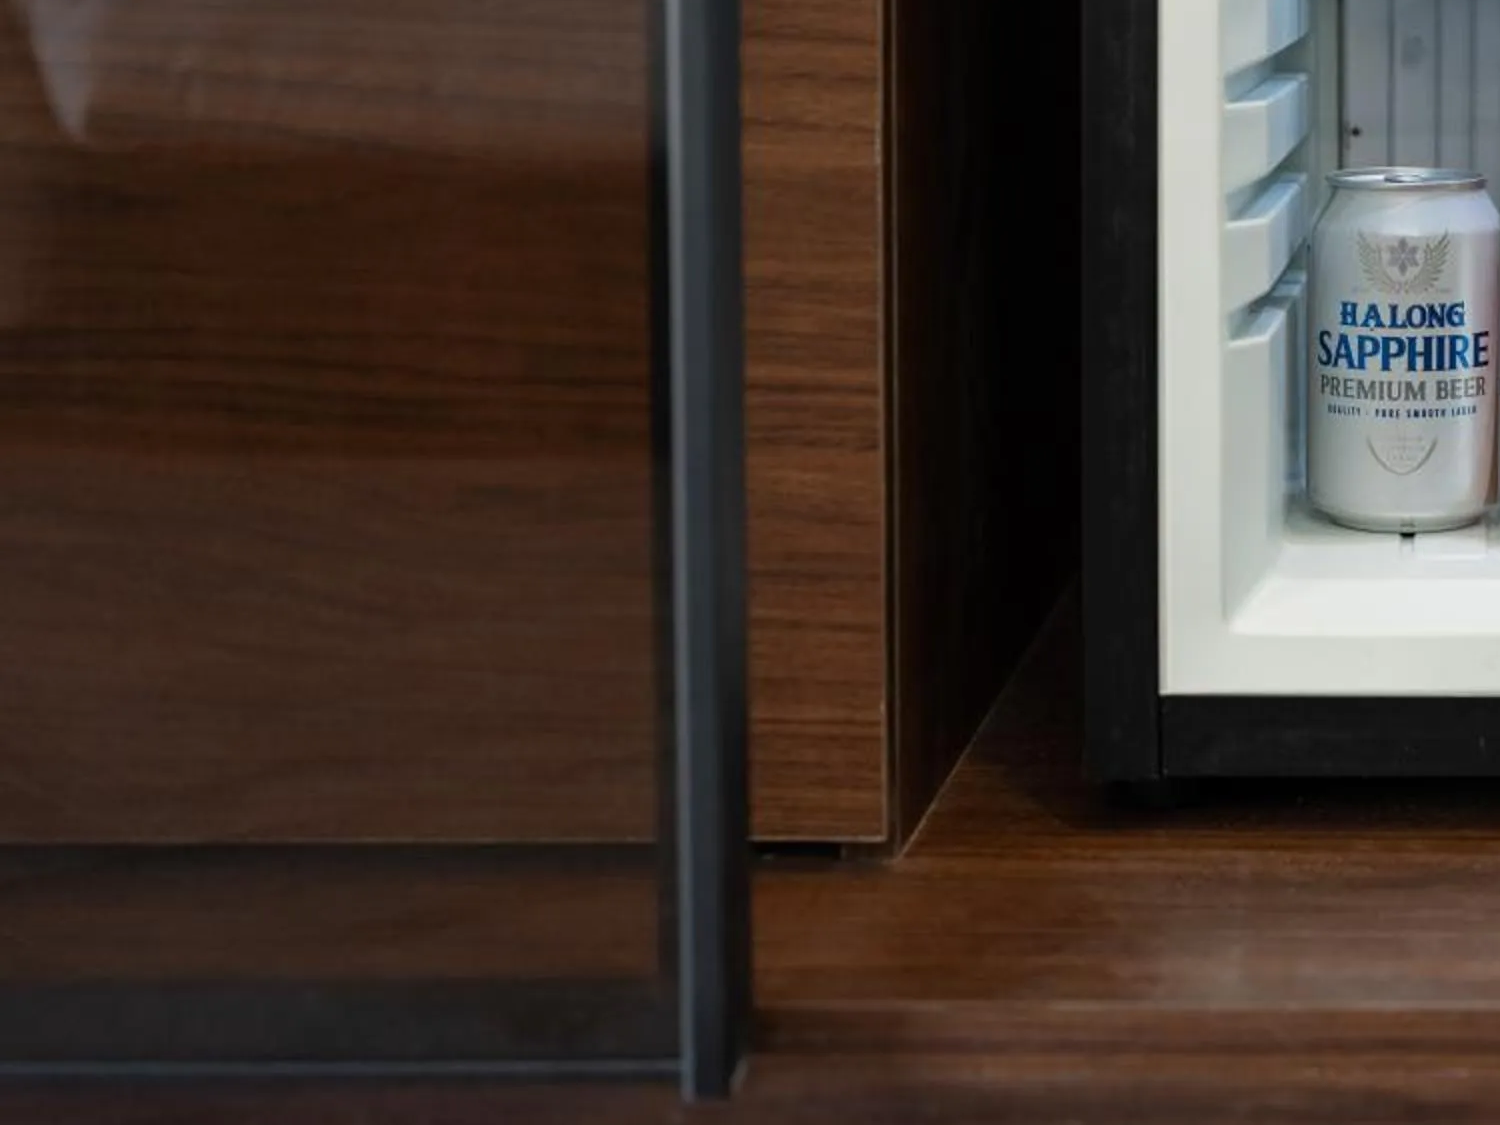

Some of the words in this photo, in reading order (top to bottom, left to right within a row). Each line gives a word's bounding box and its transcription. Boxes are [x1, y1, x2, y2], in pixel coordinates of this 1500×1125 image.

[1317, 329, 1490, 372] SAPPHIRE
[1320, 374, 1427, 402] PREMIUM
[1435, 376, 1487, 401] BEER
